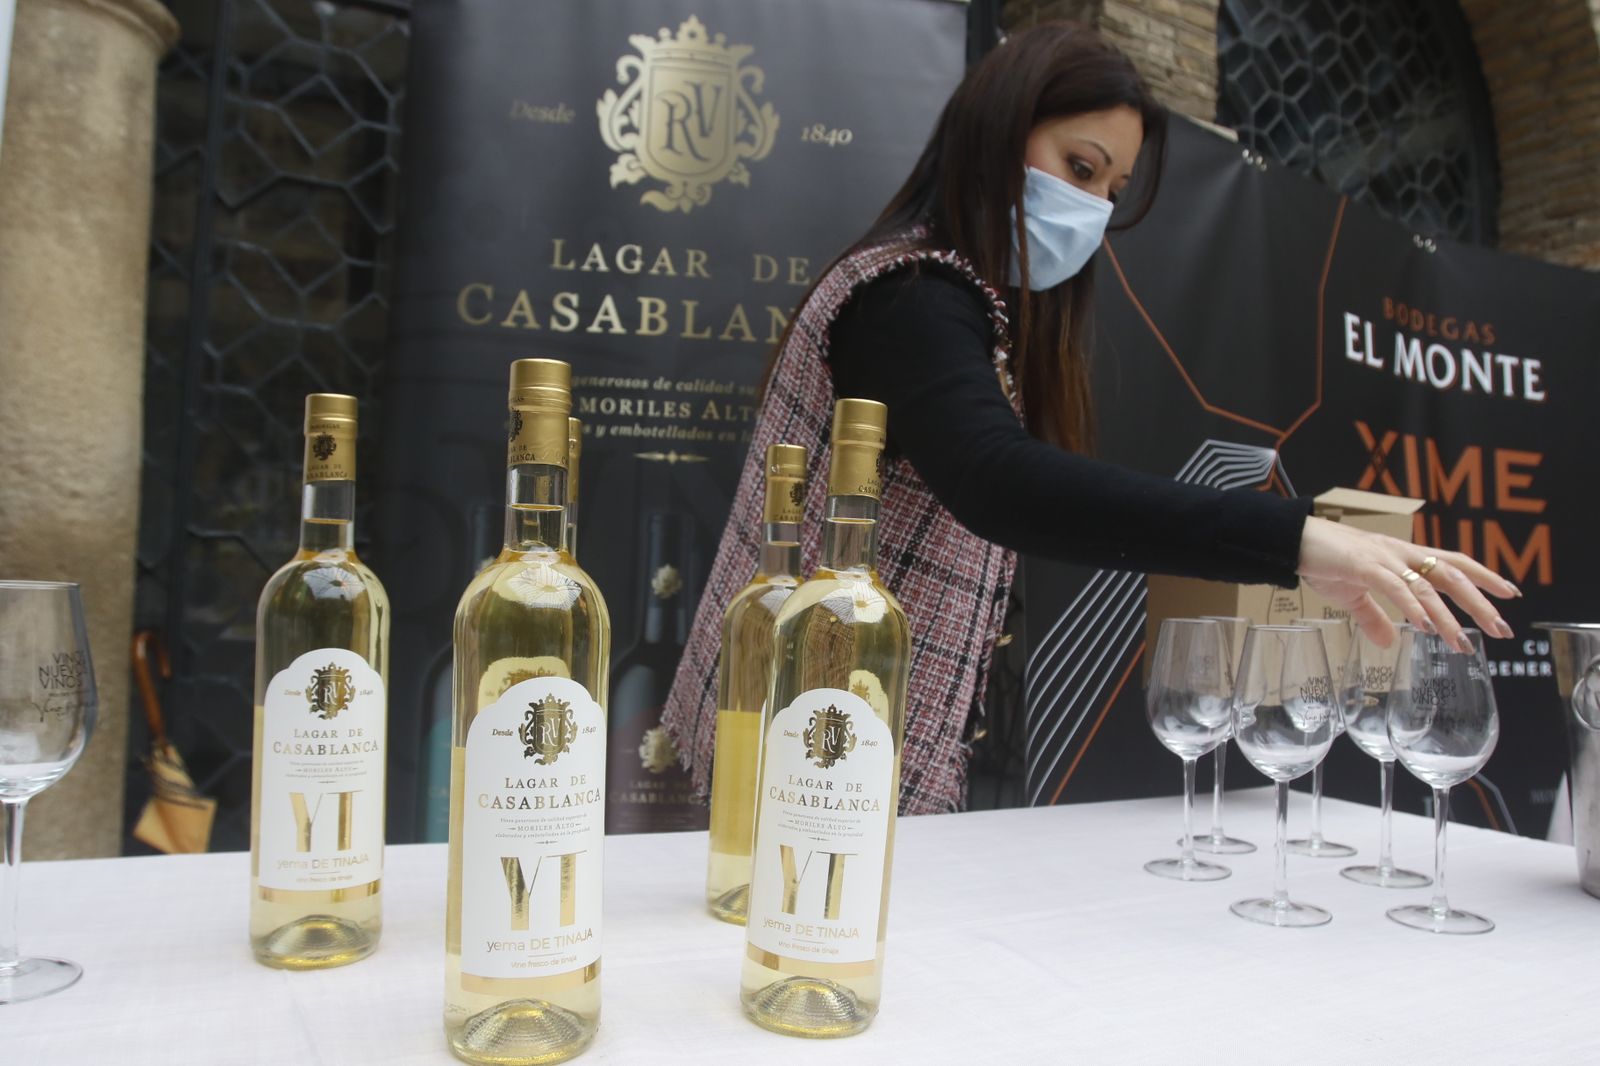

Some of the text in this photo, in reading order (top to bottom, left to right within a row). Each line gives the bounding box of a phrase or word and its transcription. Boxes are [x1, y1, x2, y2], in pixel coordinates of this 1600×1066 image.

[510, 101, 853, 147] Desde 1840
[551, 239, 813, 286] LAGAR DE
[1382, 297, 1496, 346] BODEGAS
[1344, 311, 1545, 402] EL MONTE
[653, 376, 672, 391] de
[675, 379, 734, 395] calidad
[579, 397, 762, 422] MORILES ALT
[610, 423, 713, 441] embotellados
[1355, 419, 1548, 513] XIME
[294, 728, 364, 739] LAGAR DE
[491, 728, 514, 737] Desde
[272, 739, 380, 756] CASABLANCA
[505, 773, 588, 790] LAGAR DE
[788, 775, 864, 794] LAGAR DE
[477, 787, 601, 811] CASABLANCA
[769, 786, 882, 812] CASABLANCA
[289, 789, 364, 853] YT
[311, 858, 330, 870] DE
[500, 849, 588, 931] YT
[780, 844, 858, 920] YT
[486, 927, 593, 953] yema DE TINAJA
[762, 916, 861, 939] yema DE TINAJA
